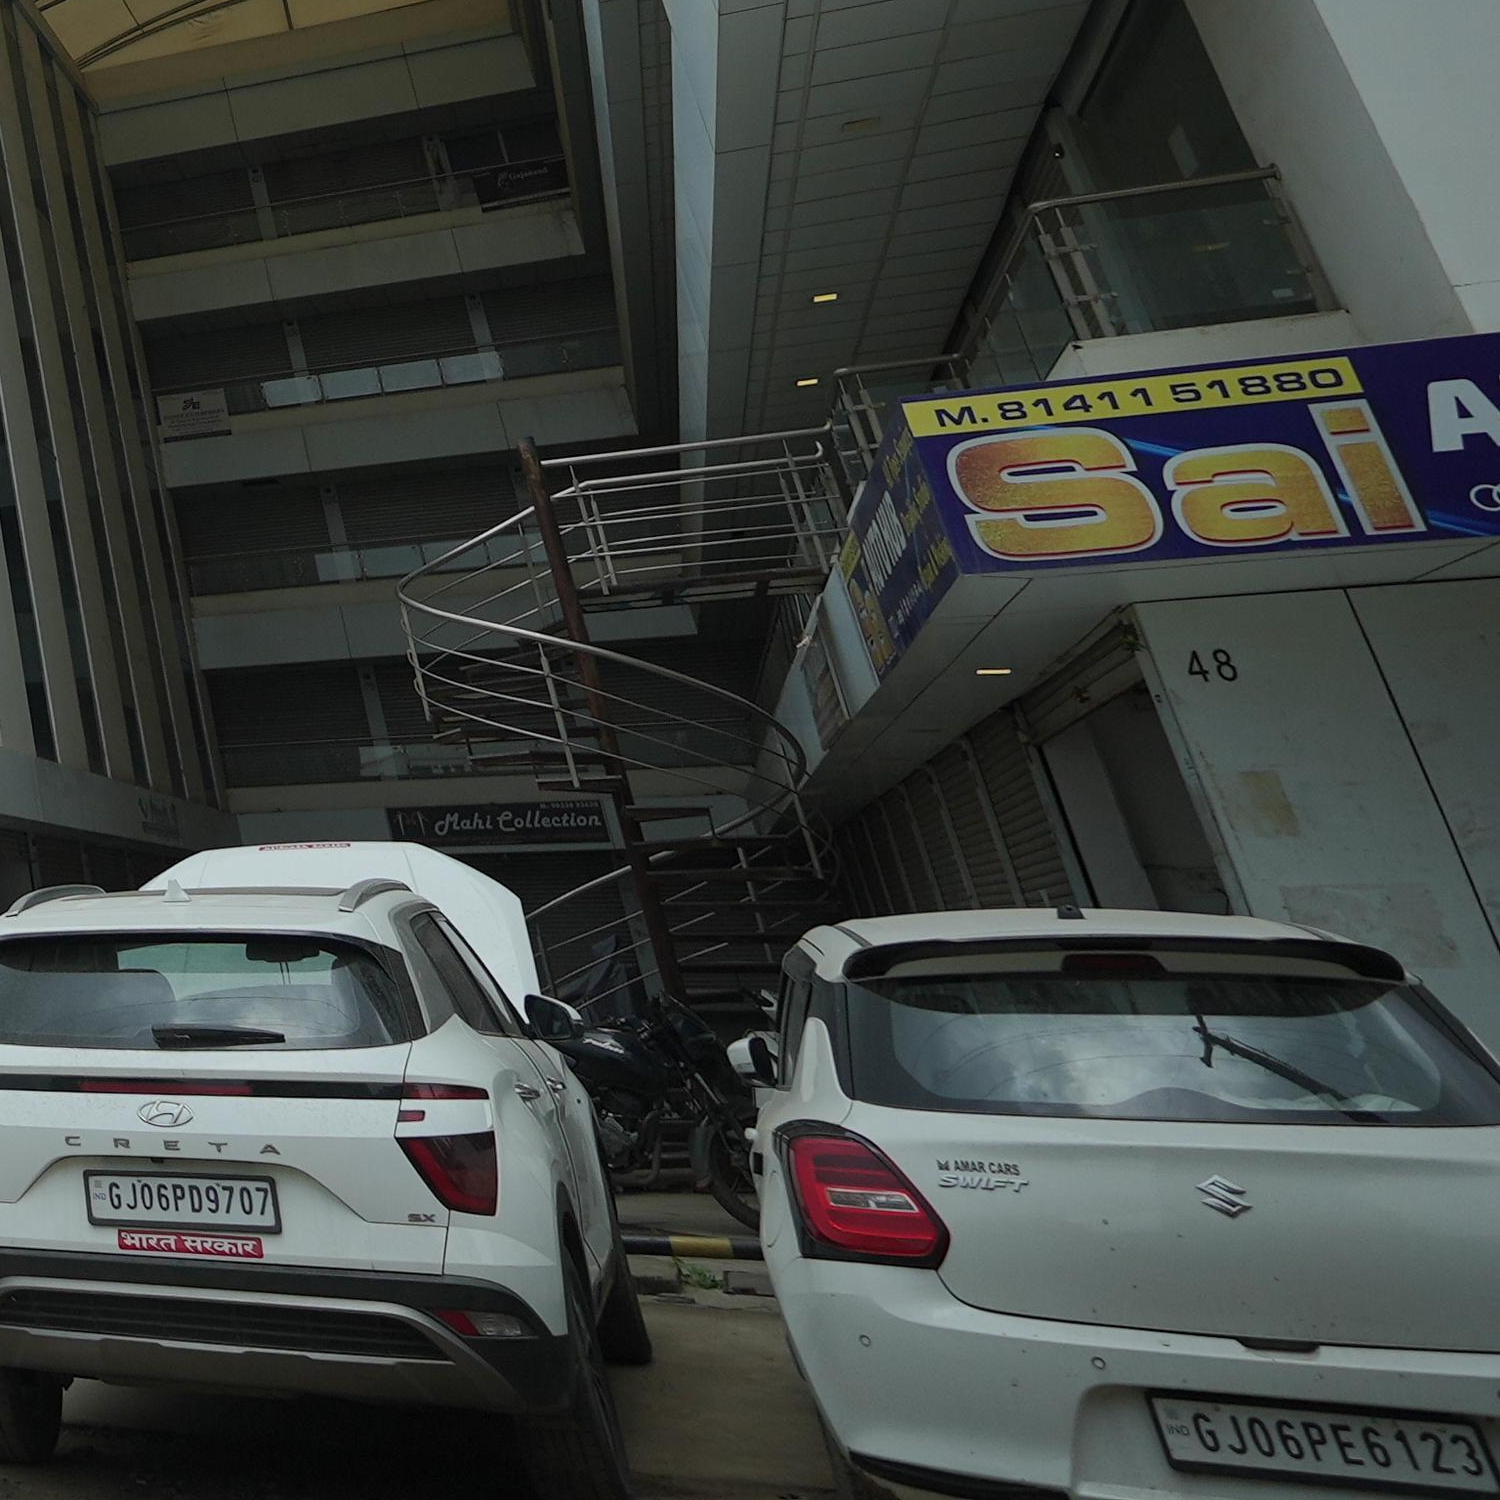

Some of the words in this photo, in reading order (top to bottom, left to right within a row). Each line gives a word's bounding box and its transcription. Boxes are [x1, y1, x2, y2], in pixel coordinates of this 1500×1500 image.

[936, 405, 989, 430] M.
[1000, 387, 1154, 422] 81411
[1170, 367, 1344, 403] 51880
[947, 398, 1428, 561] Sai
[1187, 650, 1238, 683] 48
[434, 811, 492, 835] Mahi
[497, 810, 602, 832] Collection
[64, 1136, 280, 1155] CRETA
[954, 1160, 985, 1173] AMAR
[988, 1162, 1020, 1176] CARS
[938, 1174, 1029, 1193] SWIFT
[109, 1180, 269, 1216] GJ06PD9707
[408, 1213, 436, 1222] SX
[121, 1232, 178, 1251] भारत
[184, 1235, 258, 1256] सरकार
[1192, 1412, 1483, 1477] GJ06PE6123
